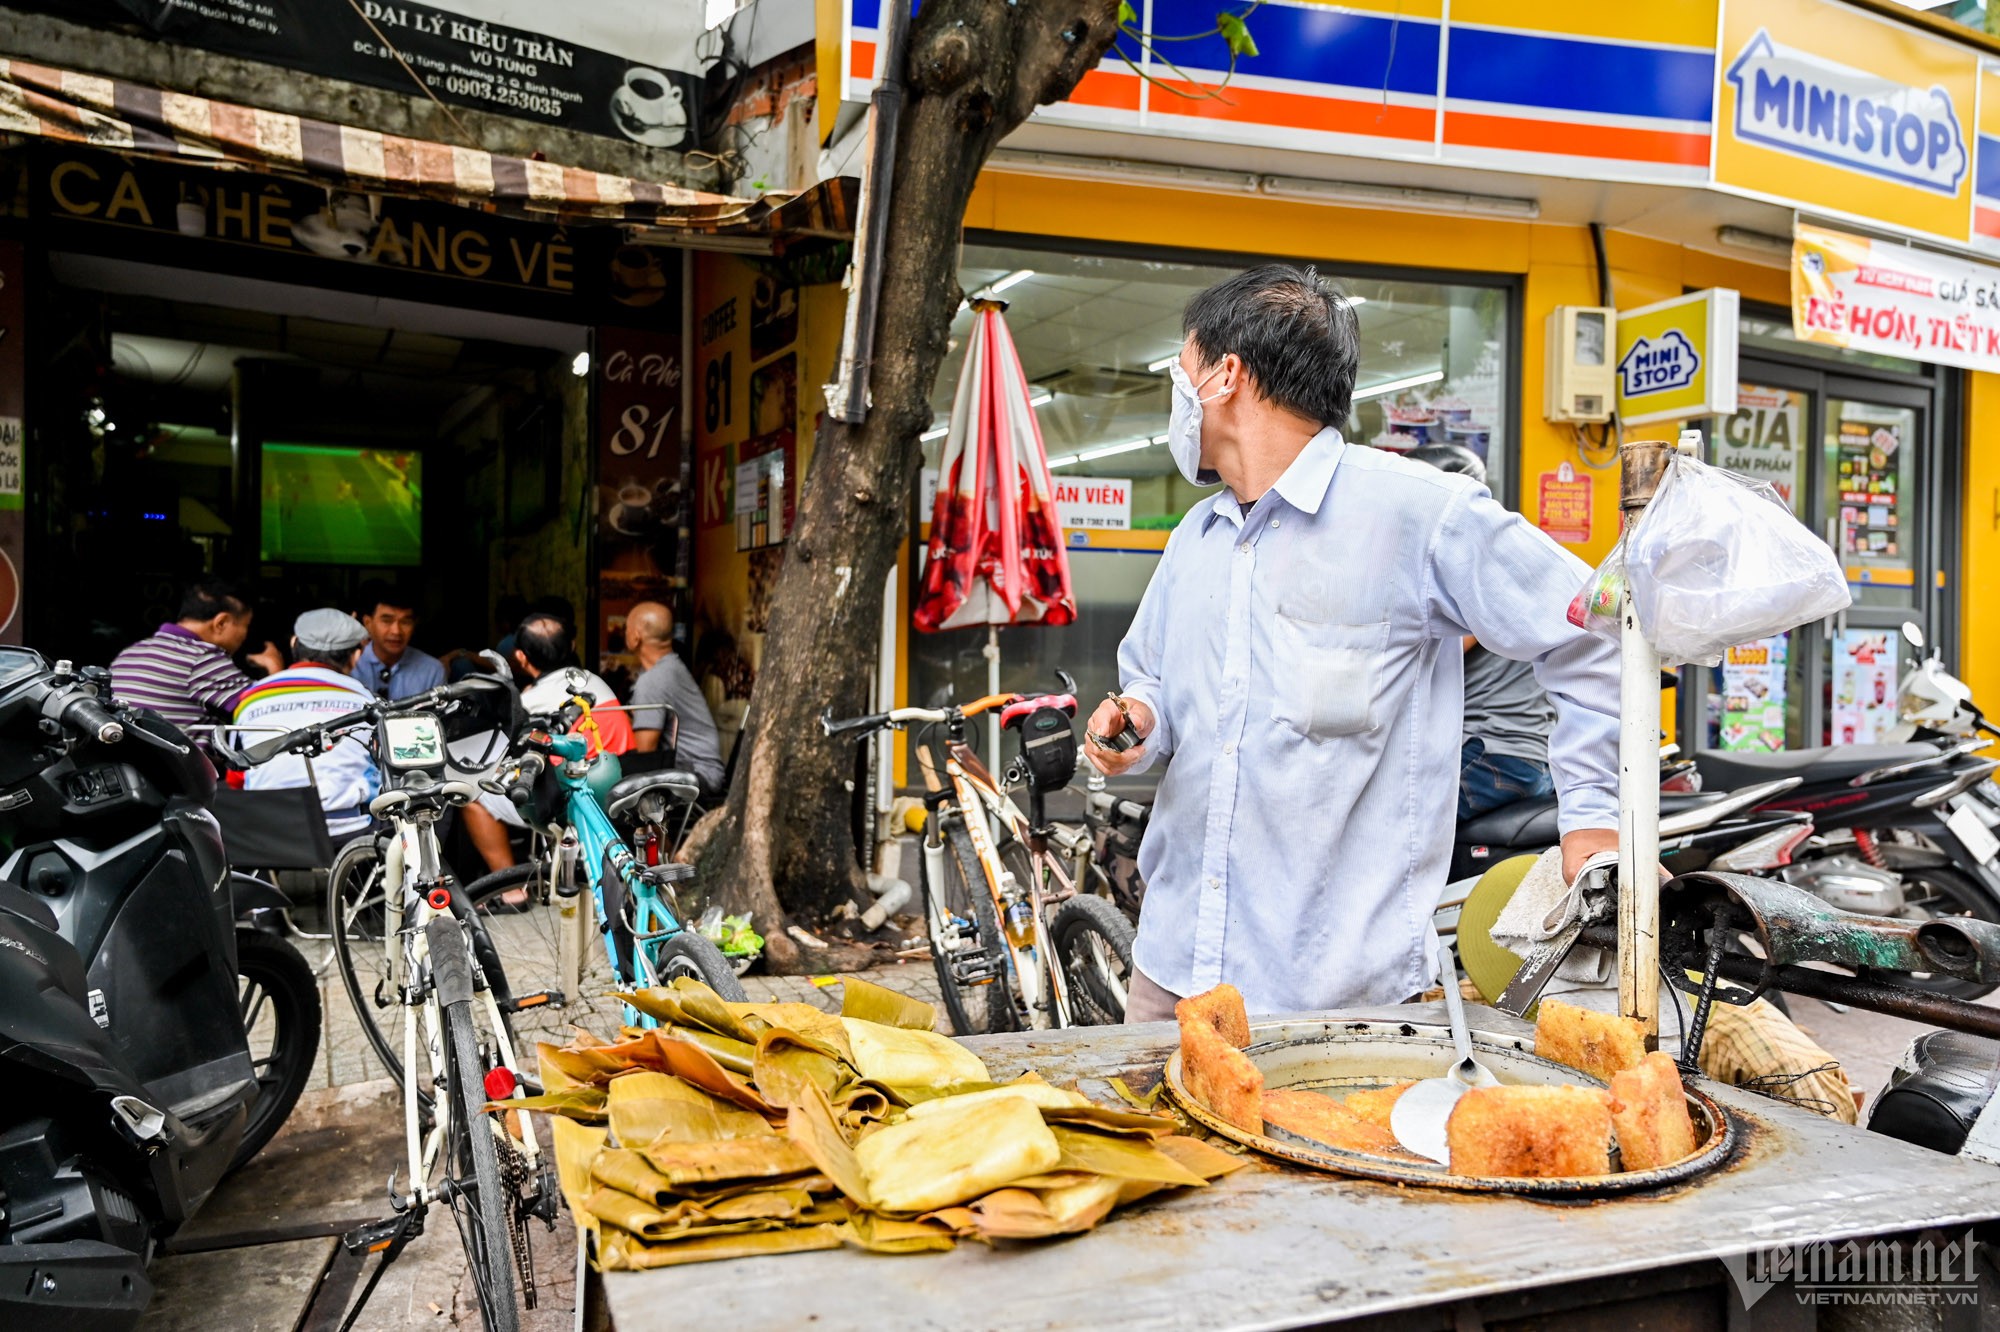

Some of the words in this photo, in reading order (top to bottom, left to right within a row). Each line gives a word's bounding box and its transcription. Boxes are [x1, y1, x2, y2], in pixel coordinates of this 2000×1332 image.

[363, 0, 408, 28] ĐẠI
[414, 12, 446, 36] LÝ
[469, 49, 493, 66] VŨ
[445, 75, 563, 118] 0903.253035
[1754, 67, 1952, 171] MINISTOP
[50, 155, 154, 226] CÀ
[1938, 277, 1970, 303] GIÁ
[1975, 280, 2000, 310] SẢ
[701, 296, 738, 347] COFFEE
[1806, 289, 1846, 331] RẺ
[1986, 327, 2000, 356] K
[605, 350, 636, 383] Cà
[1633, 364, 1682, 388] STOP
[1635, 346, 1679, 370] MINI
[704, 350, 733, 435] 81
[609, 403, 675, 460] 81
[1724, 398, 1792, 452] GIÁ
[1085, 484, 1125, 506] VIÊN
